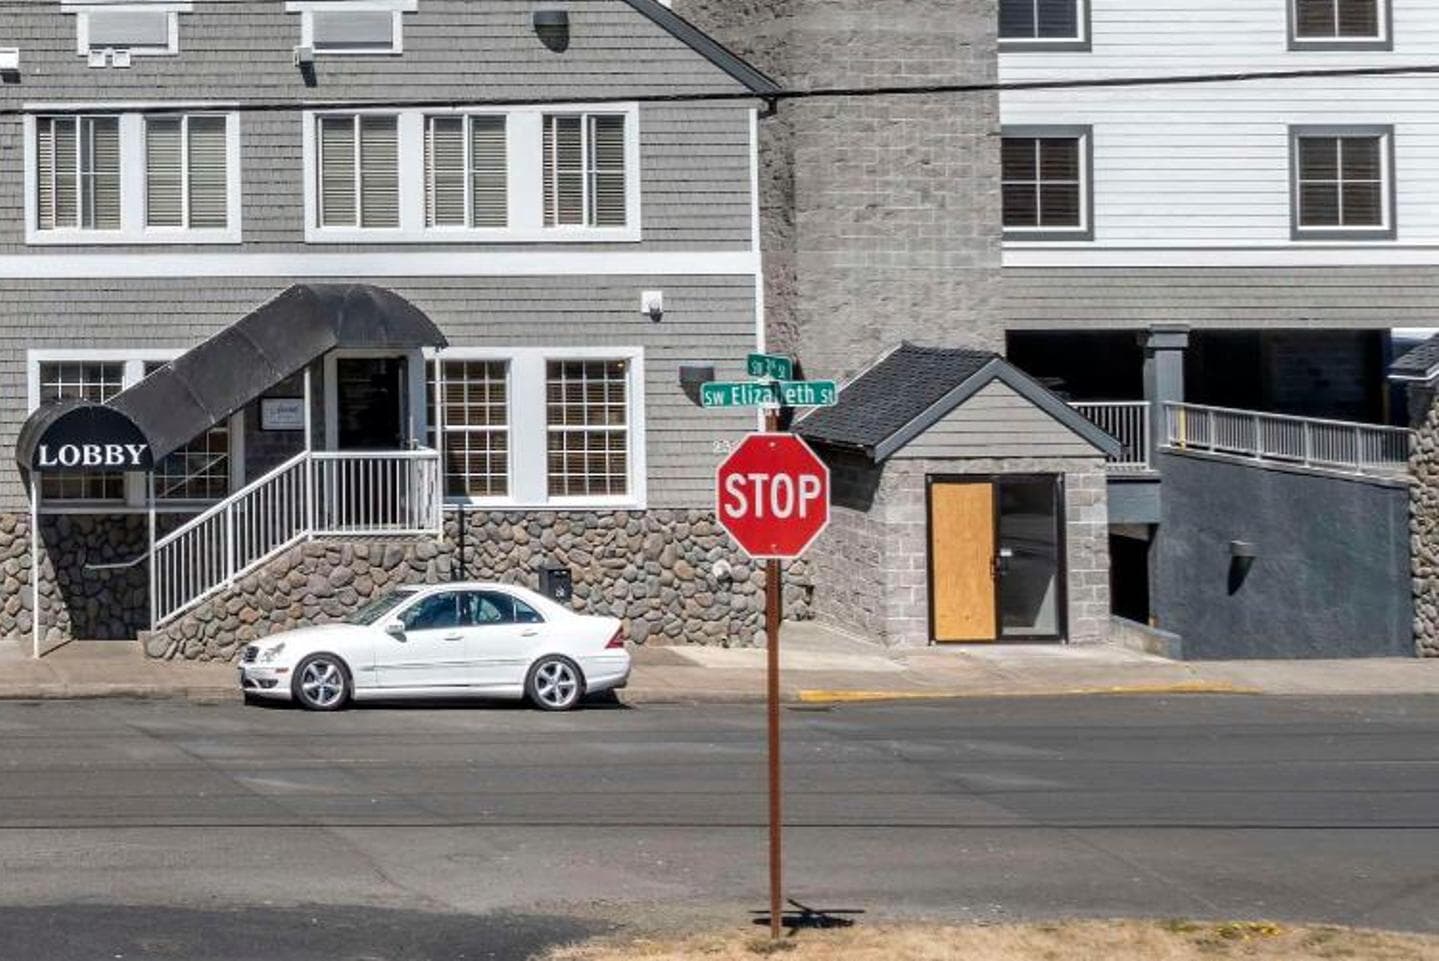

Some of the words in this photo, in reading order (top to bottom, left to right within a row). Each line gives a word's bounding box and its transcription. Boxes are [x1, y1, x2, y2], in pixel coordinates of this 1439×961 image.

[705, 390, 724, 405] SW
[731, 384, 814, 405] Elizaeth
[38, 444, 148, 467] LOBBY
[724, 473, 821, 519] STOP
